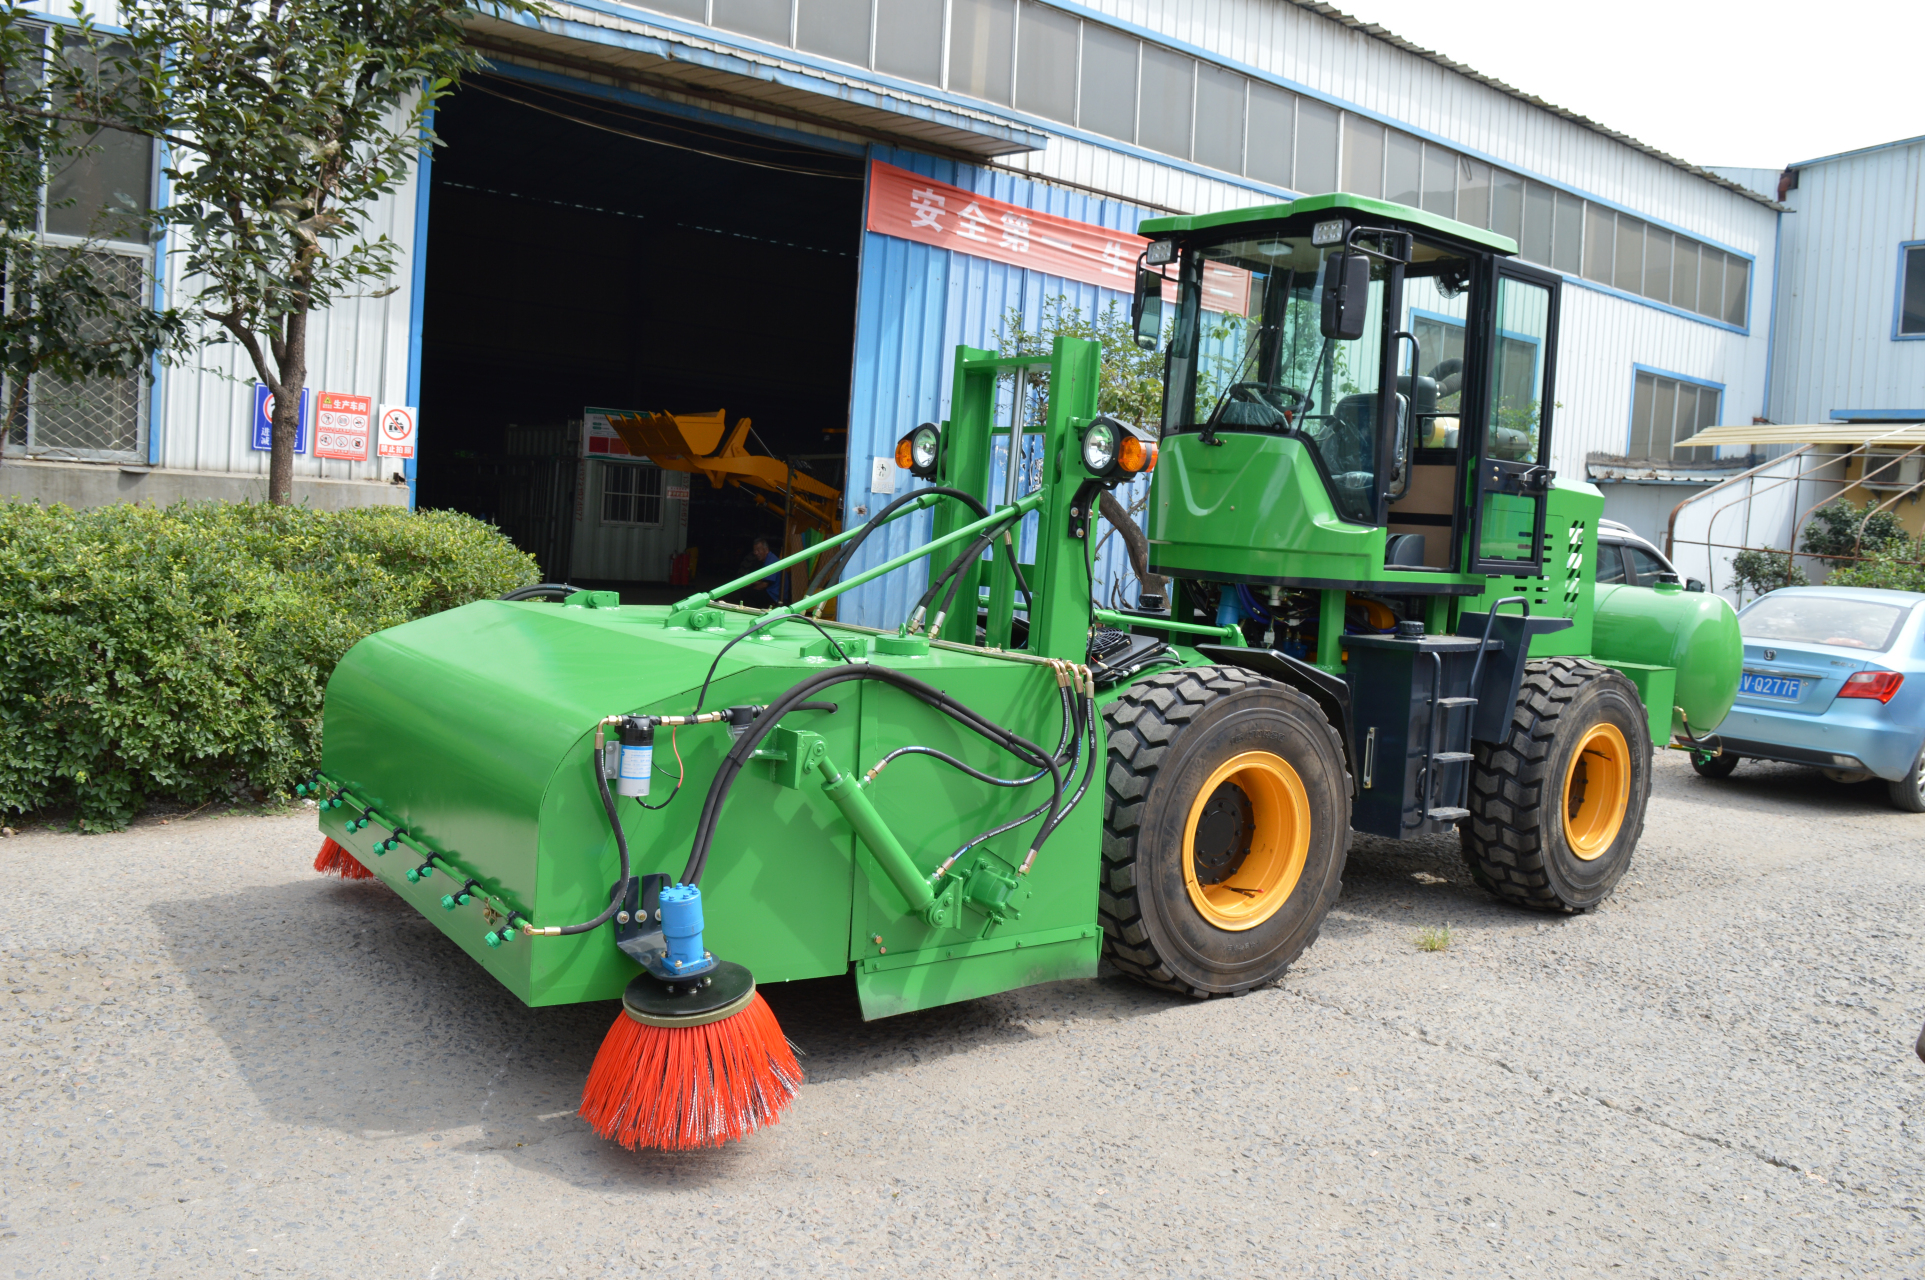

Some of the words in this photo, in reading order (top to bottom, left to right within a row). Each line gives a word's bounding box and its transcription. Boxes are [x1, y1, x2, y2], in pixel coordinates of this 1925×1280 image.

[910, 188, 1072, 253] 安全第一
[333, 399, 366, 412] 生产车间
